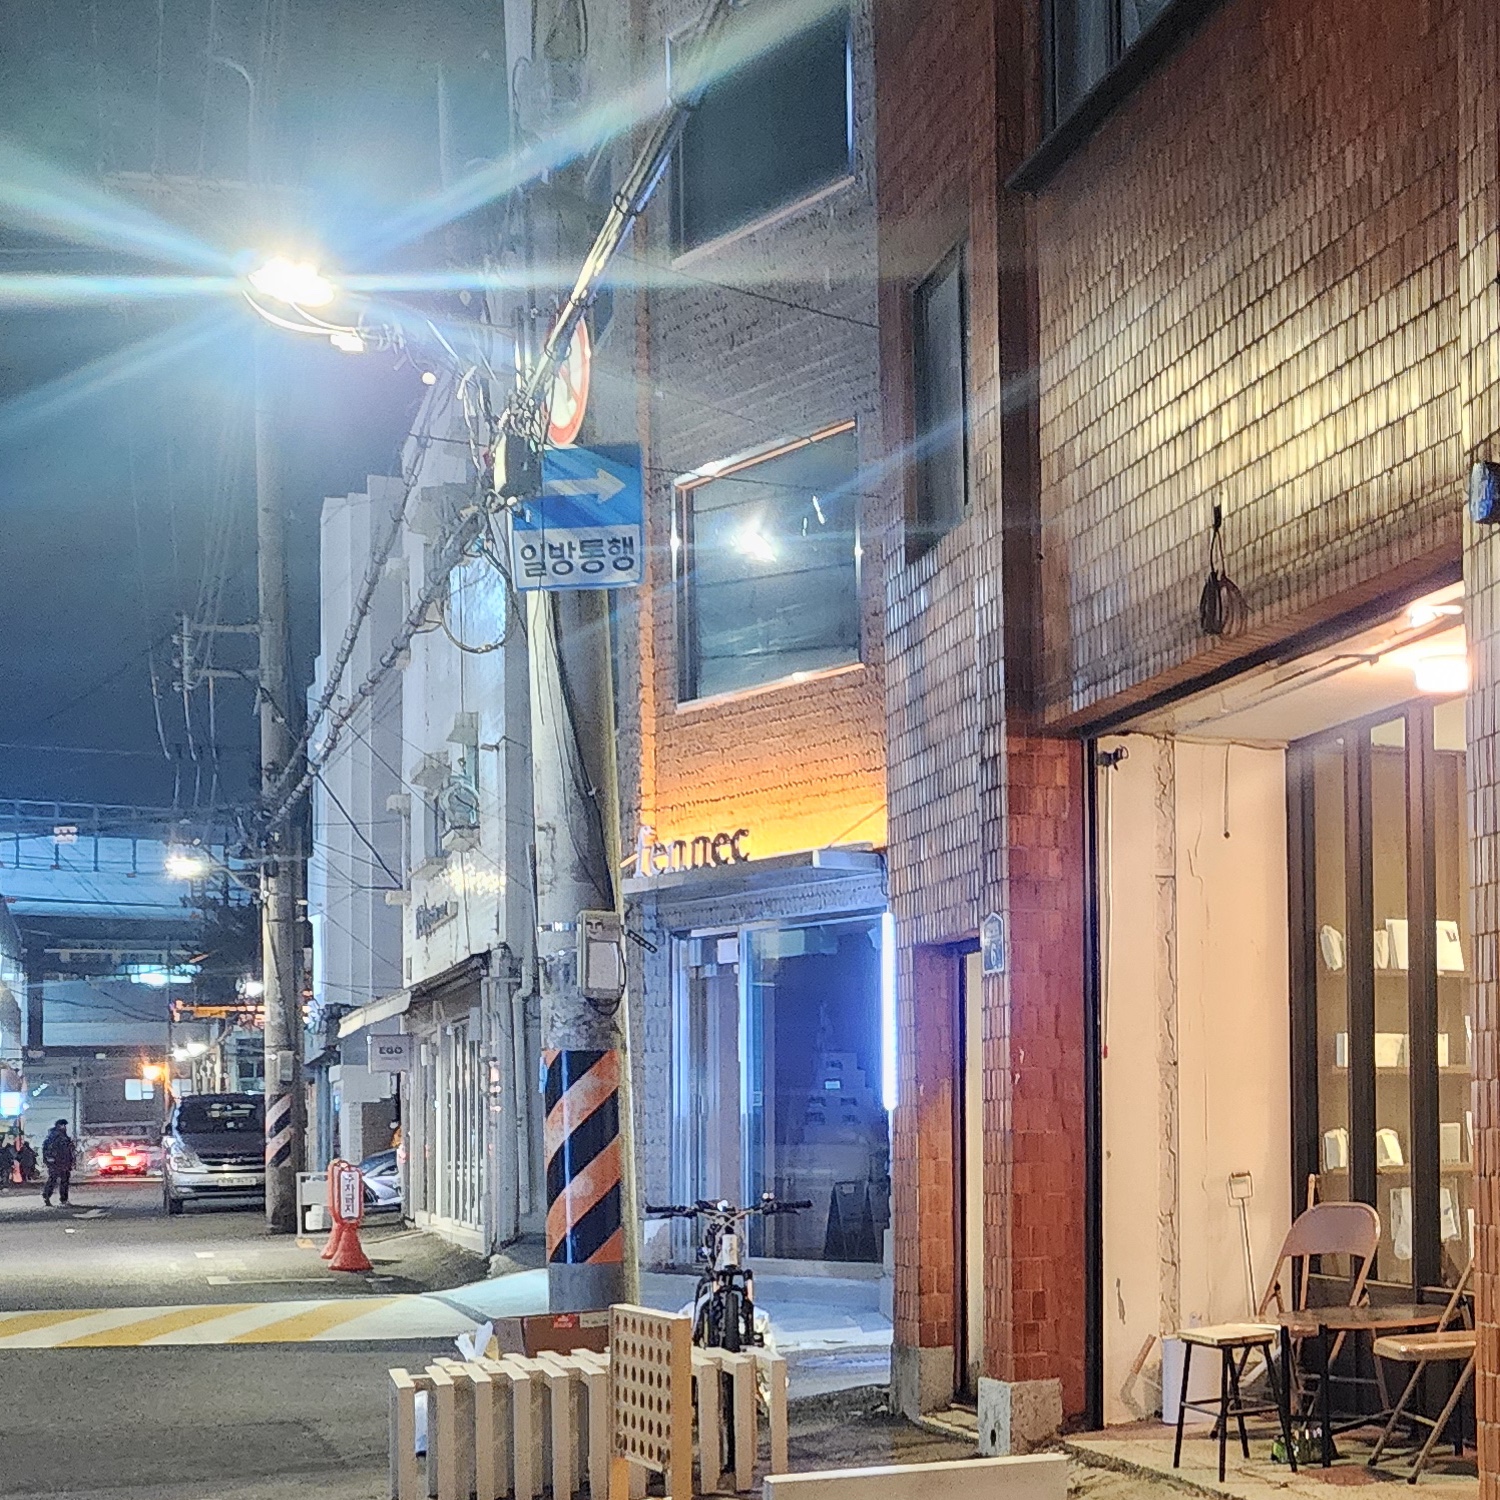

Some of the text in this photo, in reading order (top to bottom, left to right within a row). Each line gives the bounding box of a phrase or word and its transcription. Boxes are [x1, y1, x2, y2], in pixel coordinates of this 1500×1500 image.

[520, 536, 635, 577] 일방통행
[633, 826, 750, 878] fennec
[379, 1046, 403, 1055] EGO
